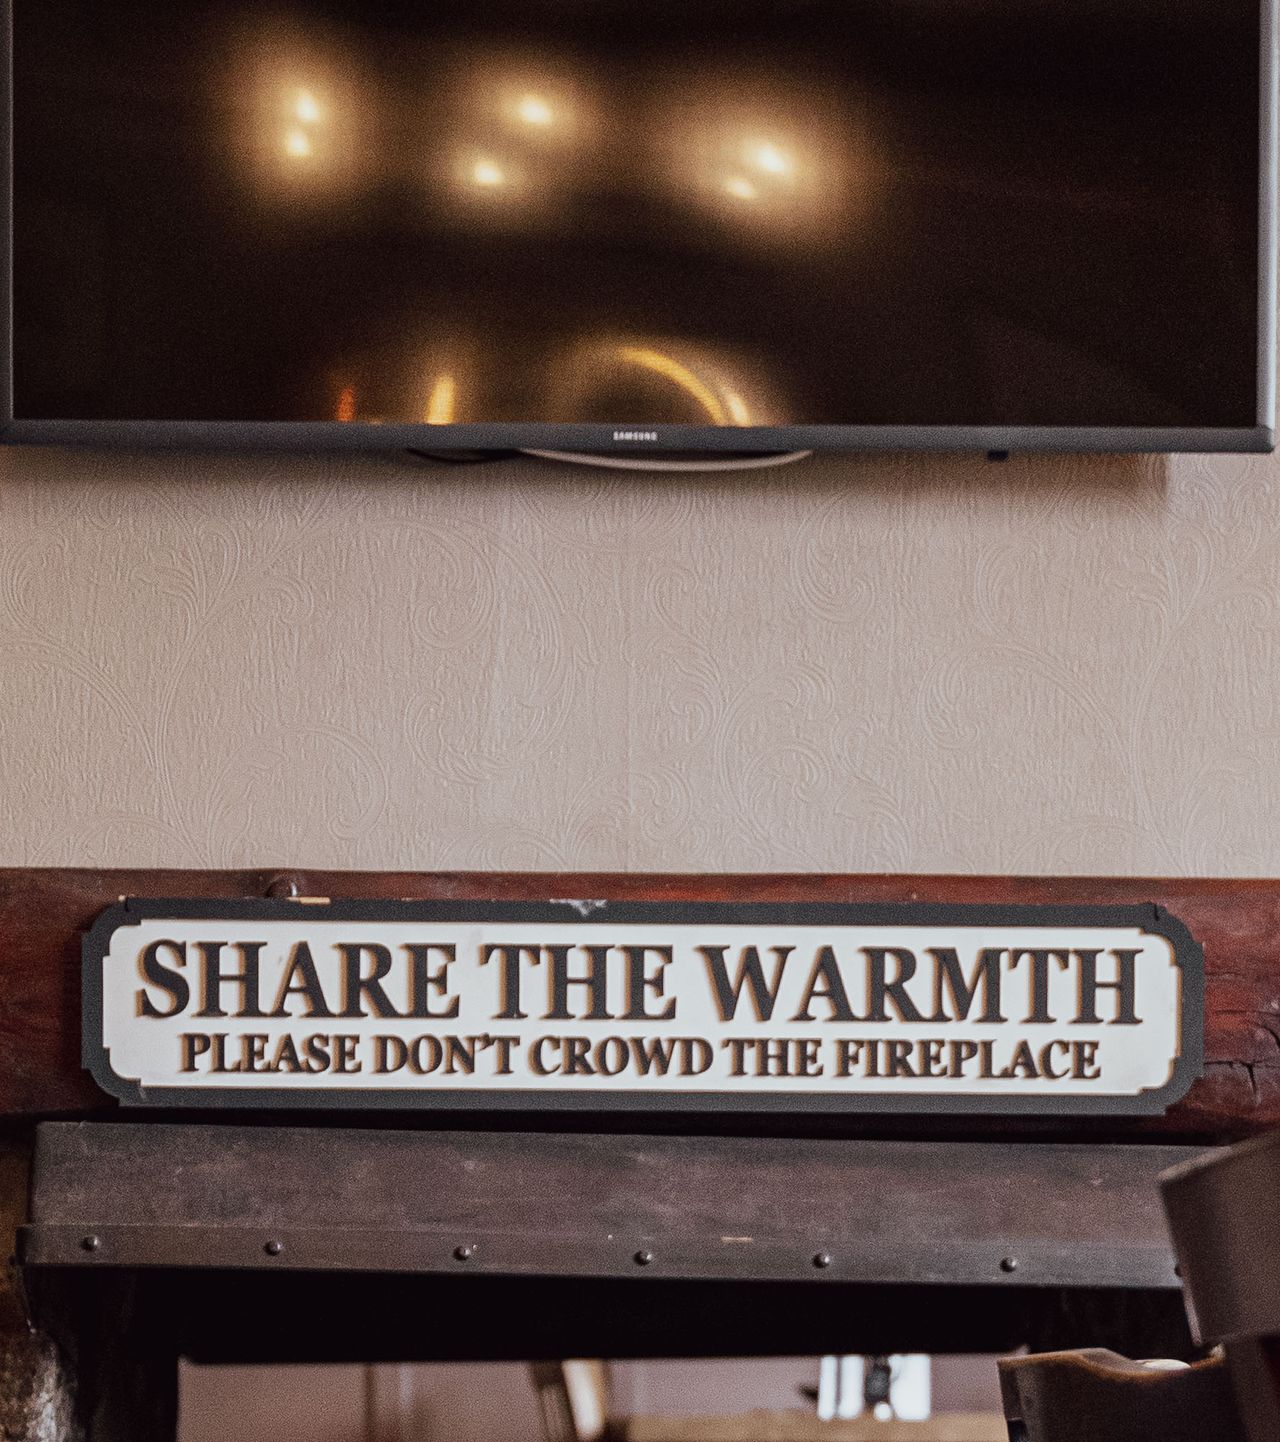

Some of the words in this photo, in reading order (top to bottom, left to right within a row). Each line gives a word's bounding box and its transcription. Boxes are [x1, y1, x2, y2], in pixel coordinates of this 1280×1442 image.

[135, 938, 461, 1020] SHARE
[478, 943, 676, 1021] THE
[693, 944, 1145, 1026] WARMTH
[178, 1032, 363, 1075] PLEASE
[370, 1032, 522, 1075] DON'T
[526, 1035, 715, 1077] CROWD
[720, 1036, 824, 1078] THE
[831, 1038, 1103, 1081] FIREPLACE
